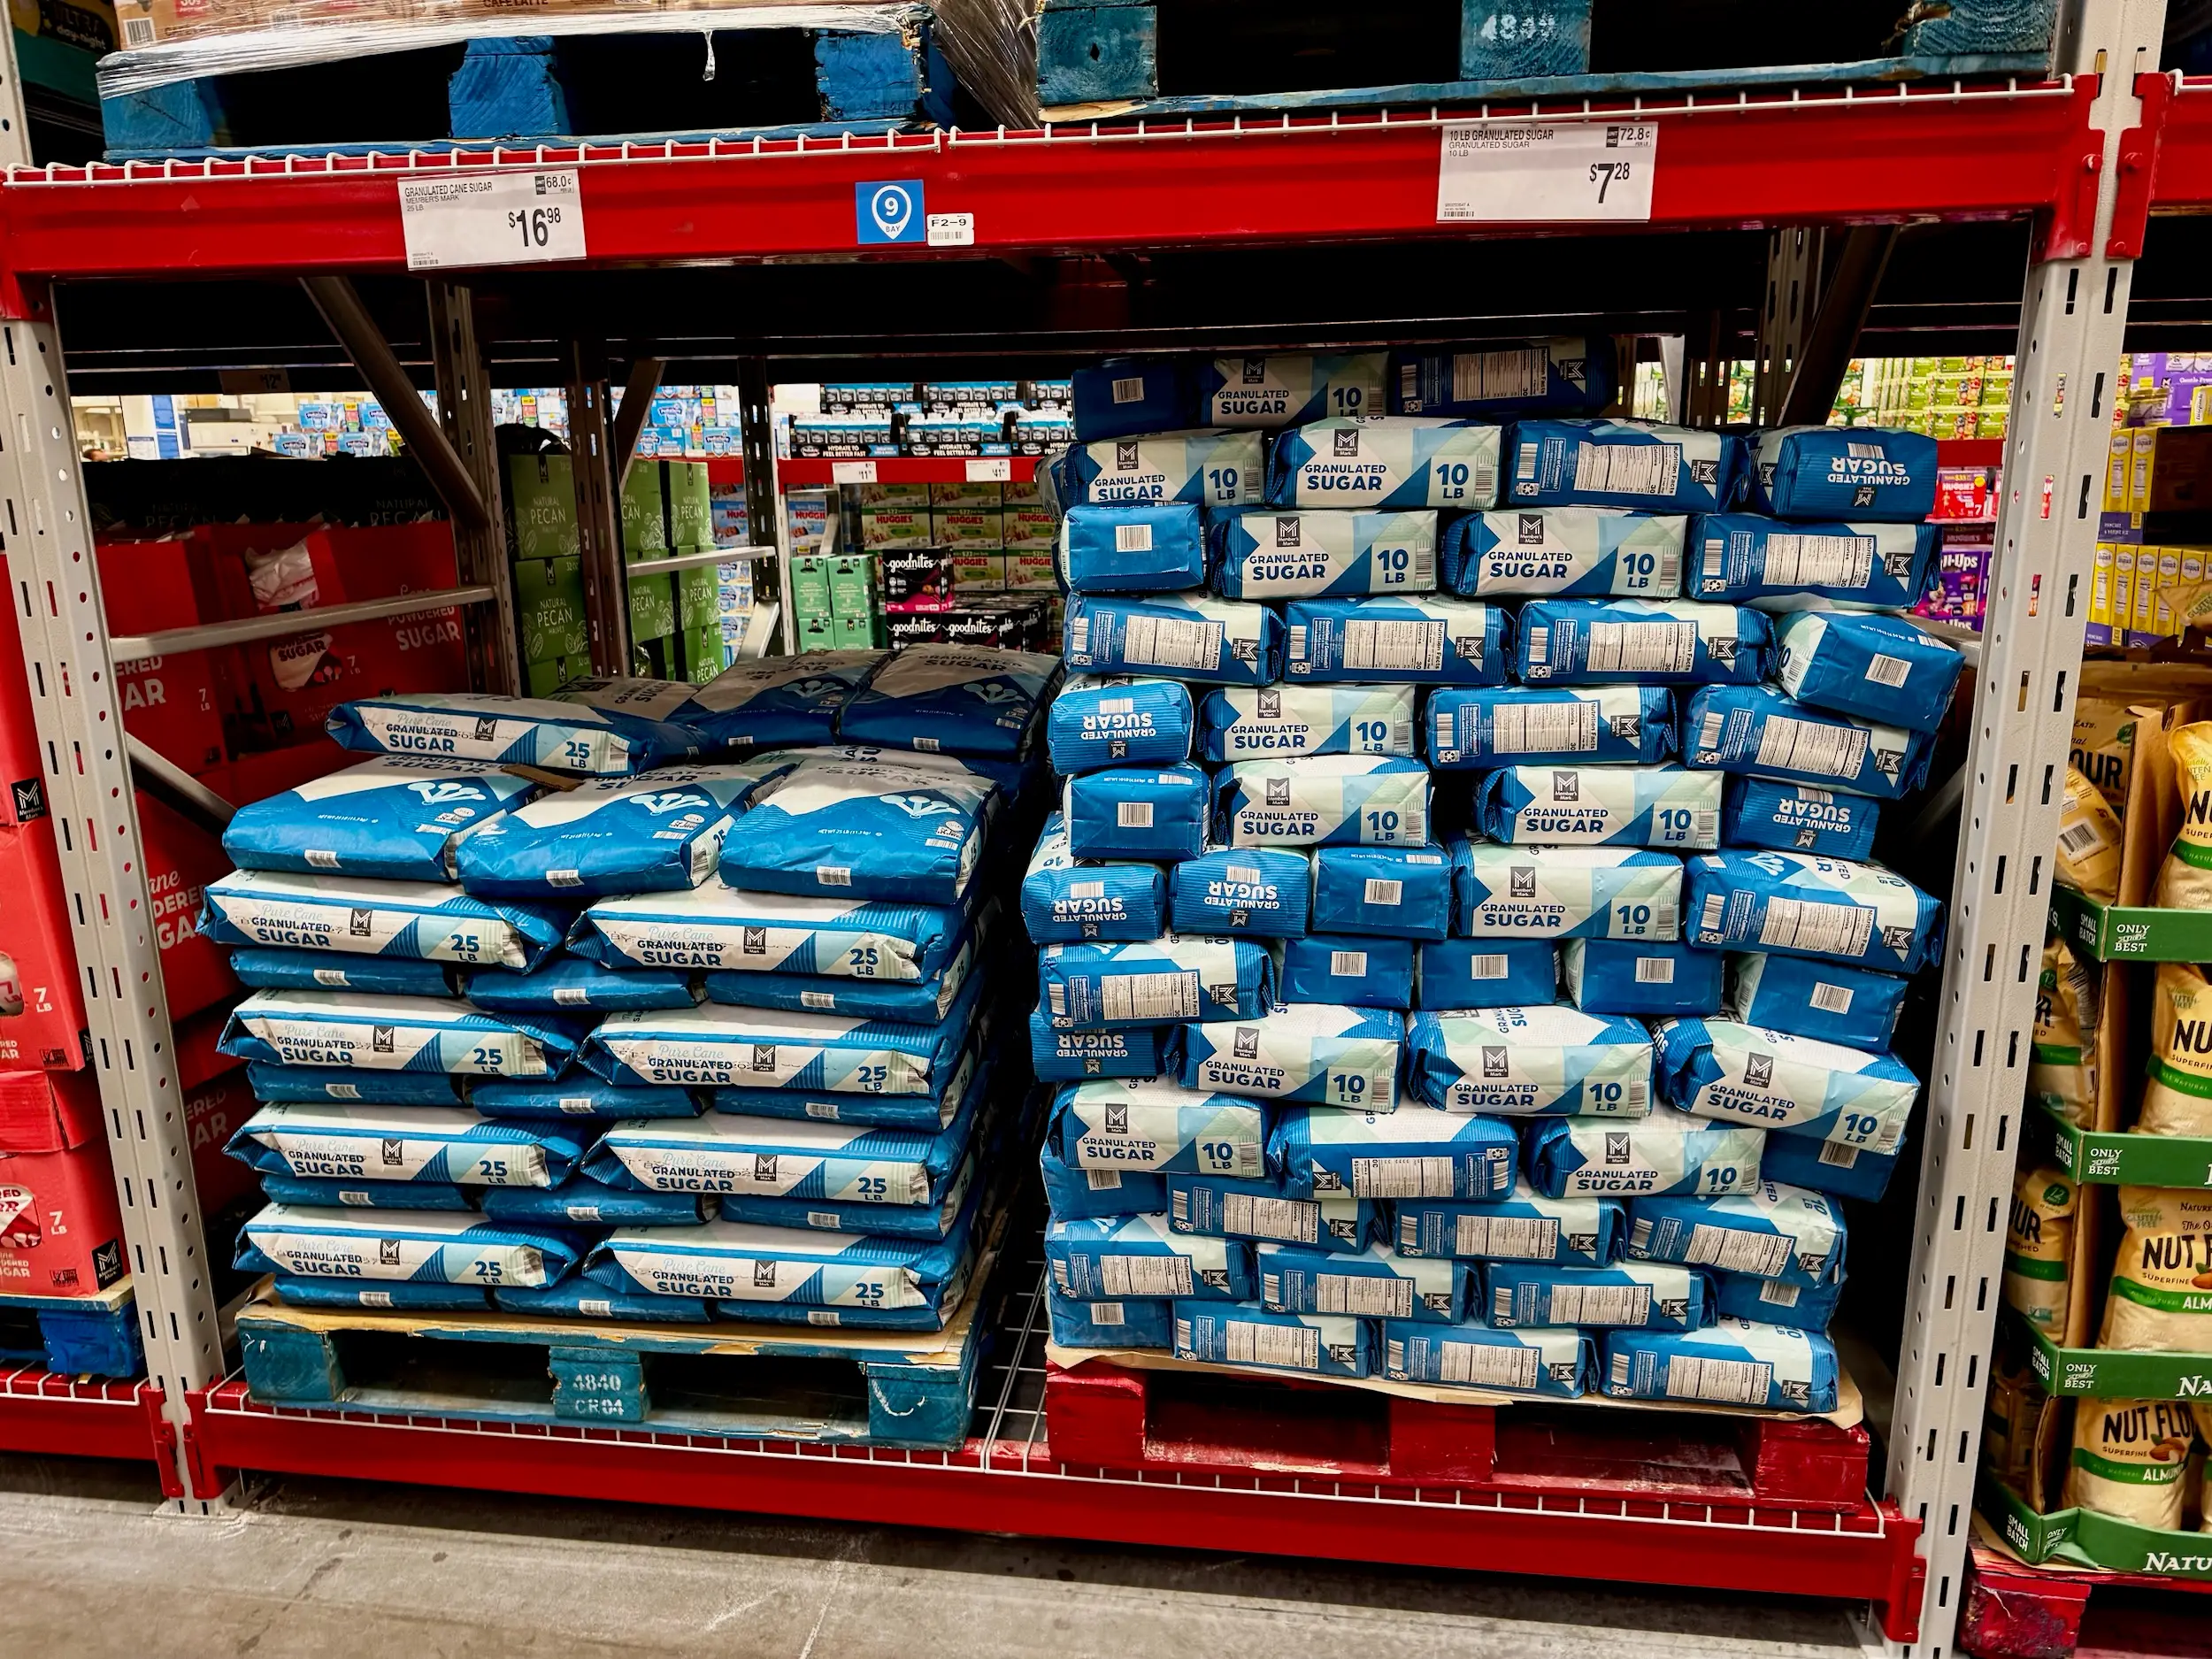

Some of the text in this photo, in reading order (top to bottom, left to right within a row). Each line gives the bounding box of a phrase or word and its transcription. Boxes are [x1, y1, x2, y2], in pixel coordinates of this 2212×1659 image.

[1449, 128, 1554, 141] 10 LB GRANULATED SUGAR
[404, 181, 493, 197] GRANULATED CANE SUGAR
[406, 195, 440, 204] MEMBER'S
[885, 196, 899, 217] 9
[1218, 390, 1289, 400] GRANULATED
[1333, 387, 1362, 408] 10
[1221, 401, 1286, 414] SUGAR
[1305, 465, 1386, 474] GRANULATED
[1832, 457, 1907, 475] SUGAR
[1307, 475, 1382, 490] SUGAR
[1437, 464, 1469, 486] 10
[1828, 473, 1910, 485] GRANULATED
[1443, 488, 1464, 499] LB
[533, 497, 559, 507] NATURAL
[531, 509, 565, 525] PECAN
[681, 506, 703, 518] PECAN
[876, 515, 913, 525] HUGGIES
[948, 516, 984, 525] HUGGIES
[888, 552, 934, 572] goodnites
[1249, 553, 1330, 565] GRANULATED
[1378, 549, 1409, 572] 10
[1488, 551, 1572, 562] GRANULATED
[1623, 553, 1655, 575] 10
[1253, 565, 1325, 580] SUGAR
[1385, 572, 1406, 584] LB
[1490, 563, 1568, 579] SUGAR
[1628, 577, 1648, 588] LB
[690, 588, 712, 601] PECAN
[540, 598, 566, 611] NATURAL
[632, 596, 655, 612] PECAN
[537, 608, 572, 627] PECAN
[893, 617, 937, 636] goodnites
[949, 618, 994, 636] goodnites
[396, 621, 460, 651] SUGAR
[278, 639, 327, 662] SUGAR
[926, 657, 1008, 673] SUGAR
[198, 687, 207, 703] 7
[201, 703, 211, 711] LB
[397, 713, 452, 726] Pure Cane
[1083, 712, 1152, 730] SUGAR
[386, 724, 458, 738] GRANULATED
[1080, 727, 1156, 741] GRANULATED
[1232, 725, 1310, 734] GRANULATED
[1356, 721, 1387, 742] 10
[388, 734, 455, 753] SUGAR
[565, 740, 590, 759] 25
[1234, 734, 1306, 749] SUGAR
[1364, 743, 1384, 752] LB
[570, 757, 588, 770] LB
[1524, 808, 1609, 818] GRANULATED
[1779, 798, 1852, 824] SUGAR
[1525, 818, 1603, 833] SUGAR
[1658, 809, 1692, 830] 10
[1772, 813, 1852, 833] GRANULATED
[1664, 830, 1686, 841] LB
[1209, 880, 1279, 901] SUGAR
[1203, 896, 1280, 910] GRANULATED
[262, 903, 323, 921] Pure Cane
[251, 917, 332, 933] GRANULATED
[2079, 912, 2097, 933] SMALL
[2116, 924, 2151, 934] ONLY
[257, 928, 332, 948] SUGAR
[649, 926, 714, 941] Pure Cane
[2078, 926, 2096, 947] BATCH
[450, 933, 480, 952] 25
[636, 939, 725, 953] GRANULATED
[2114, 942, 2147, 953] BEST
[458, 951, 479, 963] LB
[642, 950, 723, 967] SUGAR
[849, 948, 879, 966] 25
[856, 965, 874, 976] LB
[33, 987, 47, 1003] 7
[35, 1002, 53, 1013] LB
[277, 1036, 356, 1050] GRANULATED
[657, 1043, 724, 1059] Pure Cane
[281, 1047, 354, 1064] SUGAR
[473, 1048, 503, 1065] 25
[648, 1056, 734, 1071] GRANULATED
[653, 1068, 732, 1084] SUGAR
[857, 1064, 887, 1083] 25
[1206, 1060, 1285, 1078] GRANULATED
[864, 1082, 883, 1093] LB
[1209, 1070, 1281, 1090] SUGAR
[1333, 1073, 1366, 1094] 10
[1340, 1094, 1362, 1103] LB
[1709, 1083, 1795, 1110] GRANULATED
[1707, 1094, 1788, 1122] SUGAR
[1844, 1113, 1878, 1135] 10
[1082, 1137, 1156, 1149] GRANULATED
[1844, 1132, 1866, 1144] LB
[1086, 1146, 1155, 1161] SUGAR
[1202, 1142, 1233, 1161] 10
[2090, 1148, 2124, 1158] ONLY
[652, 1166, 735, 1179] GRANULATED
[1212, 1161, 1233, 1171] LB
[2088, 1165, 2120, 1176] BEST
[656, 1177, 734, 1192] SUGAR
[857, 1176, 887, 1194] 25
[49, 1210, 63, 1226] 7
[50, 1225, 67, 1235] LB
[2142, 1234, 2195, 1270] NUT
[652, 1271, 735, 1285] GRANULATED
[2142, 1272, 2190, 1286] SUPERFINE
[657, 1281, 733, 1297] SUGAR
[855, 1282, 884, 1300] 25
[572, 1373, 622, 1392] 4840
[2102, 1406, 2149, 1443] NUT
[2102, 1446, 2148, 1457] SUPERFINE
[2008, 1514, 2030, 1540] SMALL
[2007, 1525, 2029, 1552] BATCH
